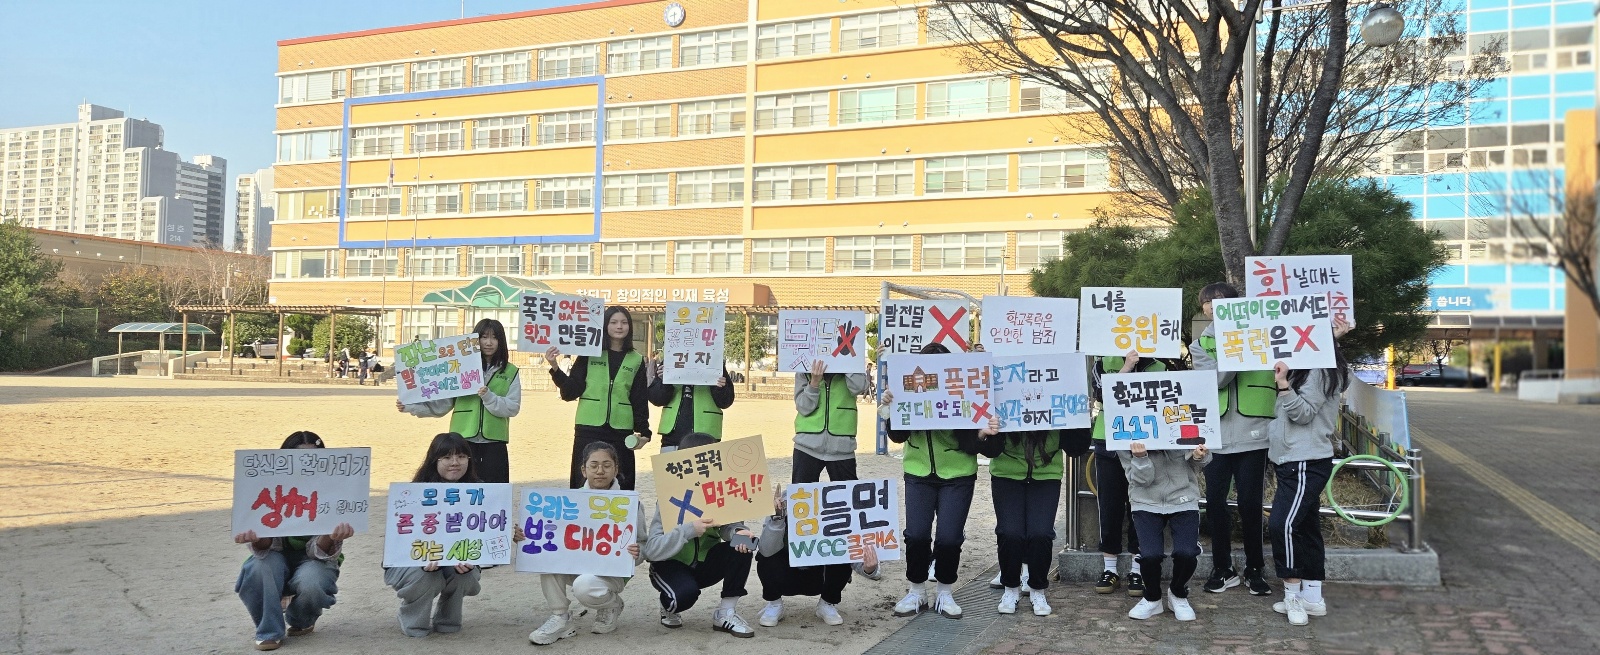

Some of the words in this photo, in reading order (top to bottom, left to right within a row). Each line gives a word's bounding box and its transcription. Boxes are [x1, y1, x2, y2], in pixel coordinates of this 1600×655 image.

[169, 234, 181, 242] 214
[617, 288, 667, 303] 창의적인
[672, 288, 698, 303] 인재
[703, 288, 729, 303] 육성
[1091, 290, 1127, 313] 너를
[1436, 296, 1472, 307] 씁니다
[522, 296, 556, 321] 폭력
[559, 299, 590, 321] 없는
[673, 307, 714, 325] 우리
[1006, 310, 1053, 328] 학교폭력은
[524, 322, 551, 344] 학교
[558, 324, 602, 347] 만들기
[884, 334, 923, 354] 이간질
[1032, 329, 1057, 345] 범죄
[1222, 325, 1293, 365] 폭력은
[673, 351, 712, 369] 걷자
[400, 367, 417, 390] 말
[416, 359, 462, 384] 한마디가
[460, 369, 481, 390] 상처
[944, 366, 991, 399] 폭력
[1112, 380, 1183, 412] 학교폭력
[1050, 393, 1089, 428] 말아요
[1163, 403, 1207, 424] 신고는
[1112, 415, 1159, 440] 117
[243, 453, 294, 478] 당신의
[298, 453, 370, 477] 한마디가
[251, 485, 330, 529] 상처가
[336, 500, 369, 515] 됩니다
[421, 488, 485, 506] 모두가
[525, 492, 580, 520] 우리는
[589, 495, 631, 523] 모두
[790, 480, 890, 537] 힘들면
[522, 516, 559, 555] 보호
[410, 539, 443, 562] 하는
[446, 538, 483, 562] 세상
